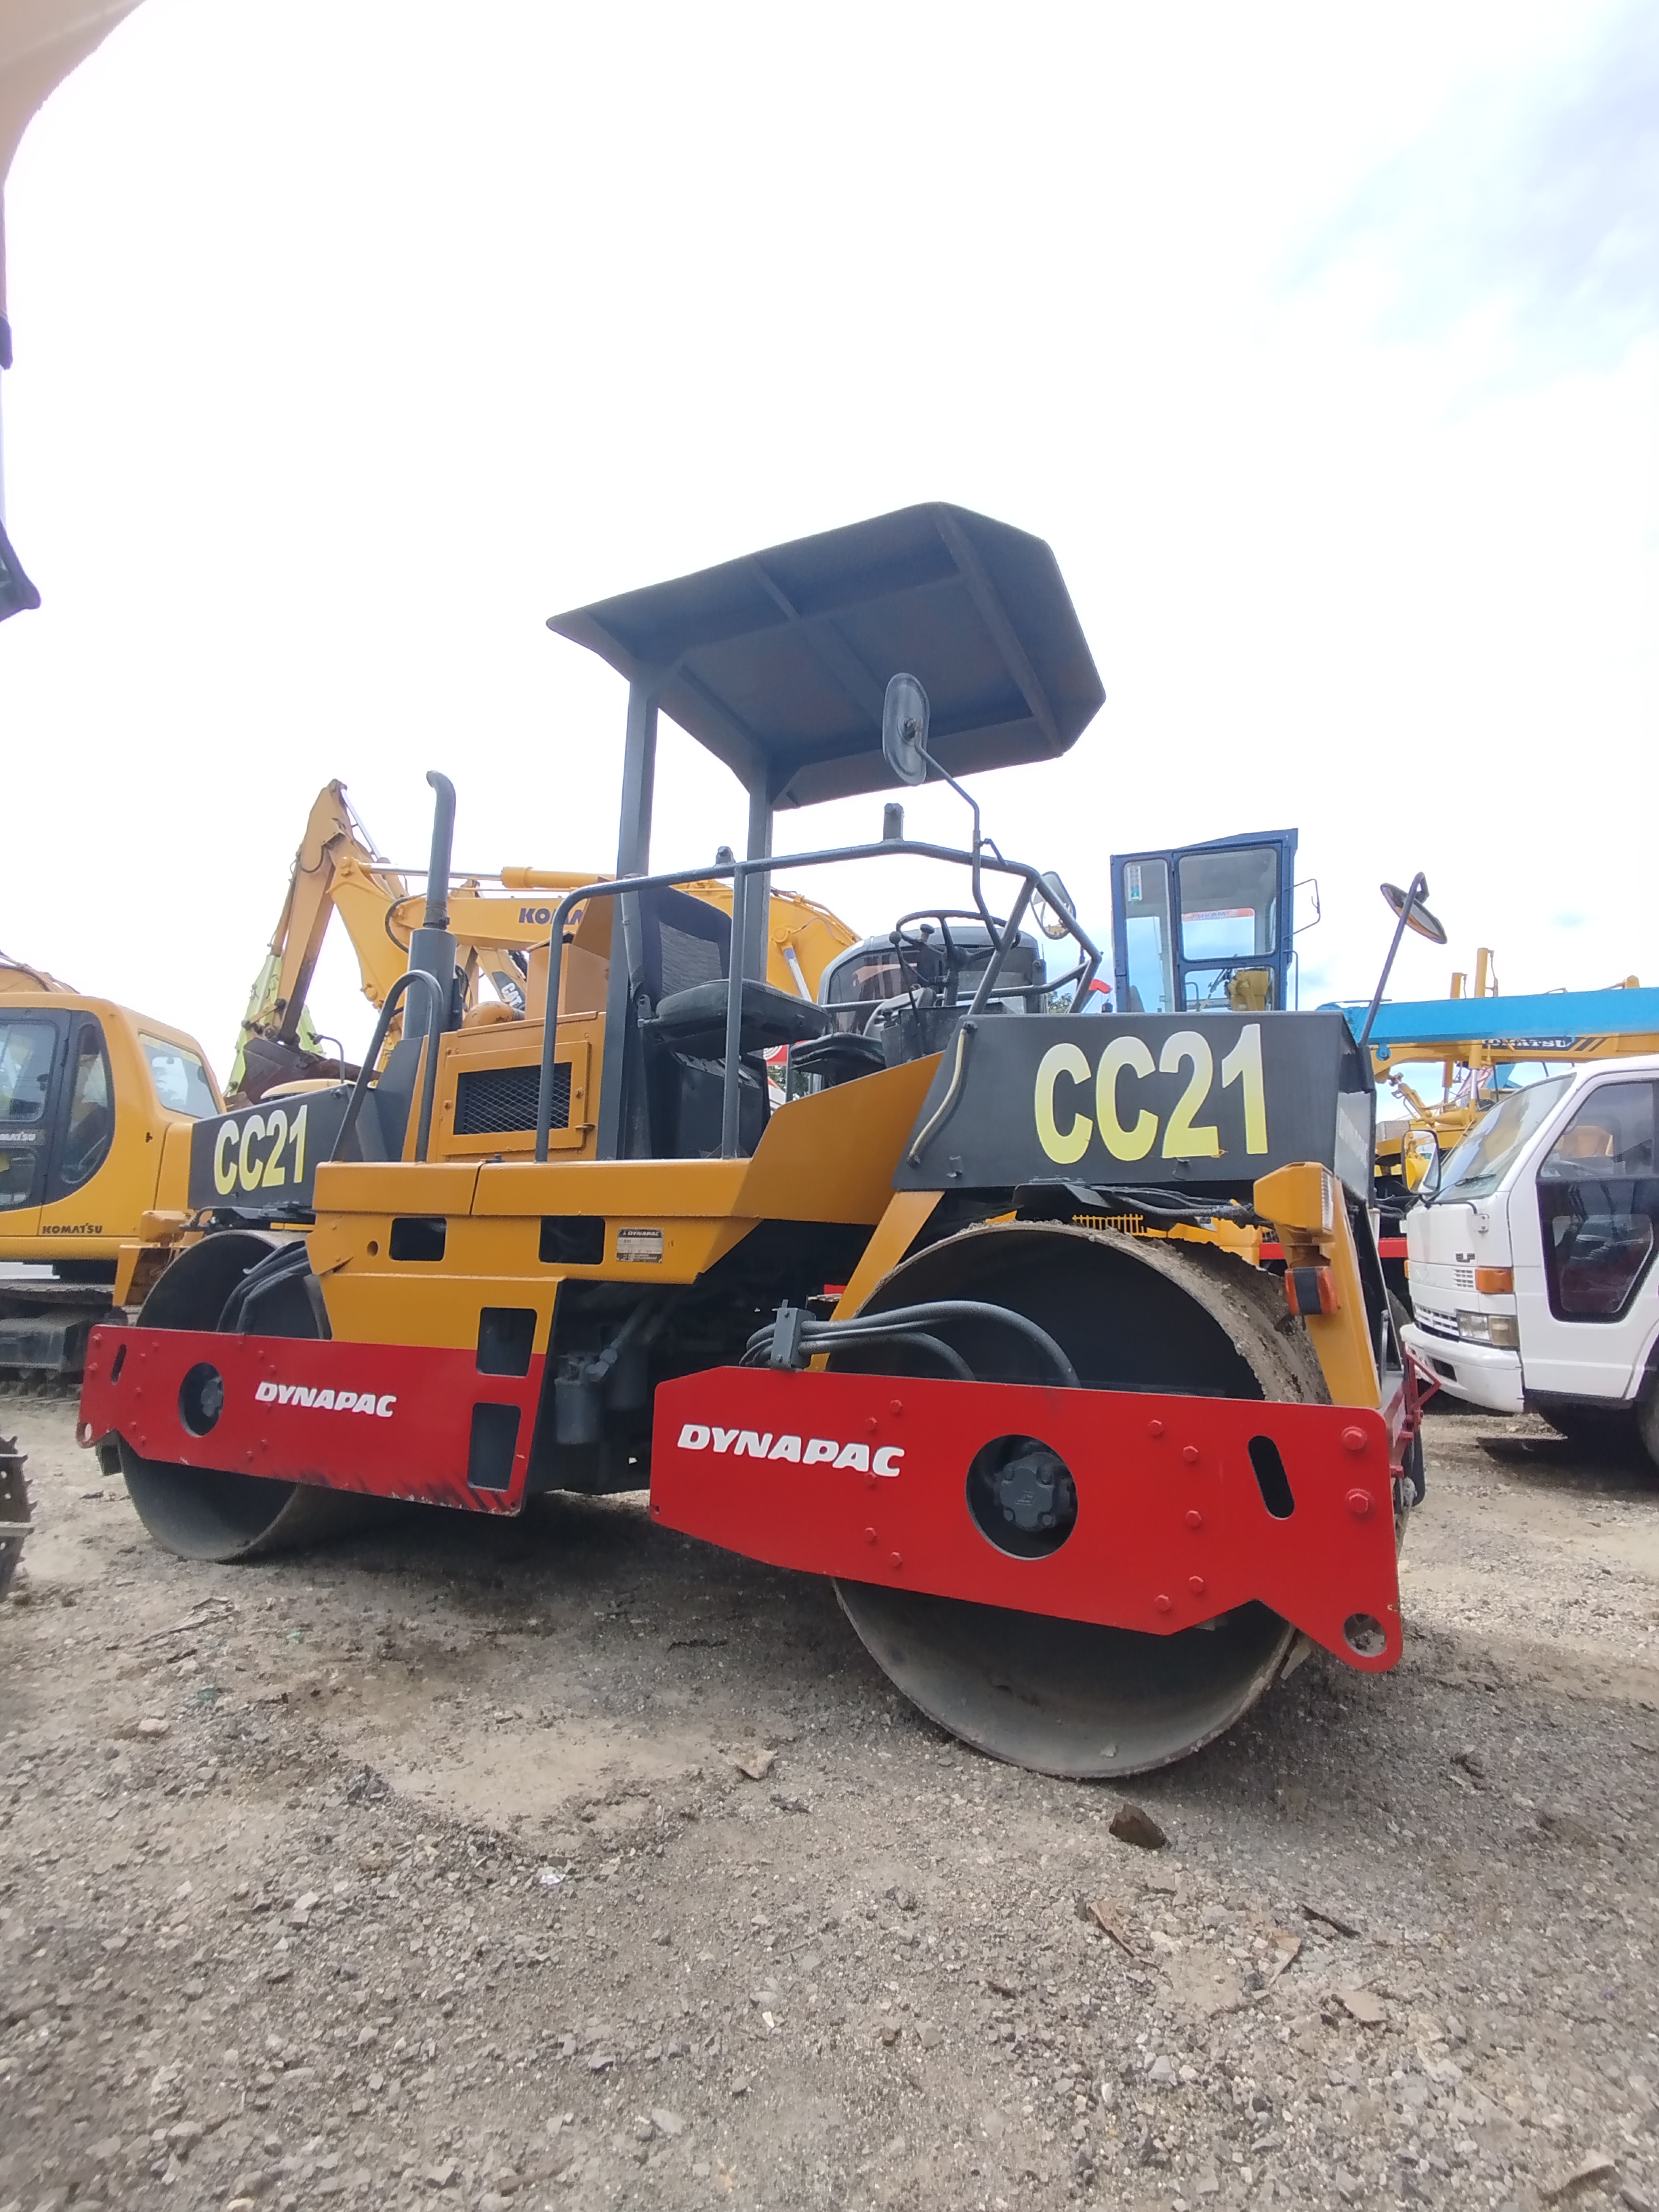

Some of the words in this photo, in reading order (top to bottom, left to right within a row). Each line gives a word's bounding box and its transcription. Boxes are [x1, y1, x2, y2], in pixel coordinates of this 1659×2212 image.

[1035, 1023, 1268, 1164] CC21
[0, 1132, 36, 1141] MATSU
[214, 1105, 308, 1195] CC21
[42, 1223, 103, 1234] KOMATSU
[255, 1381, 397, 1417] DYNAPAC
[677, 1424, 905, 1477] DYNAPAC
